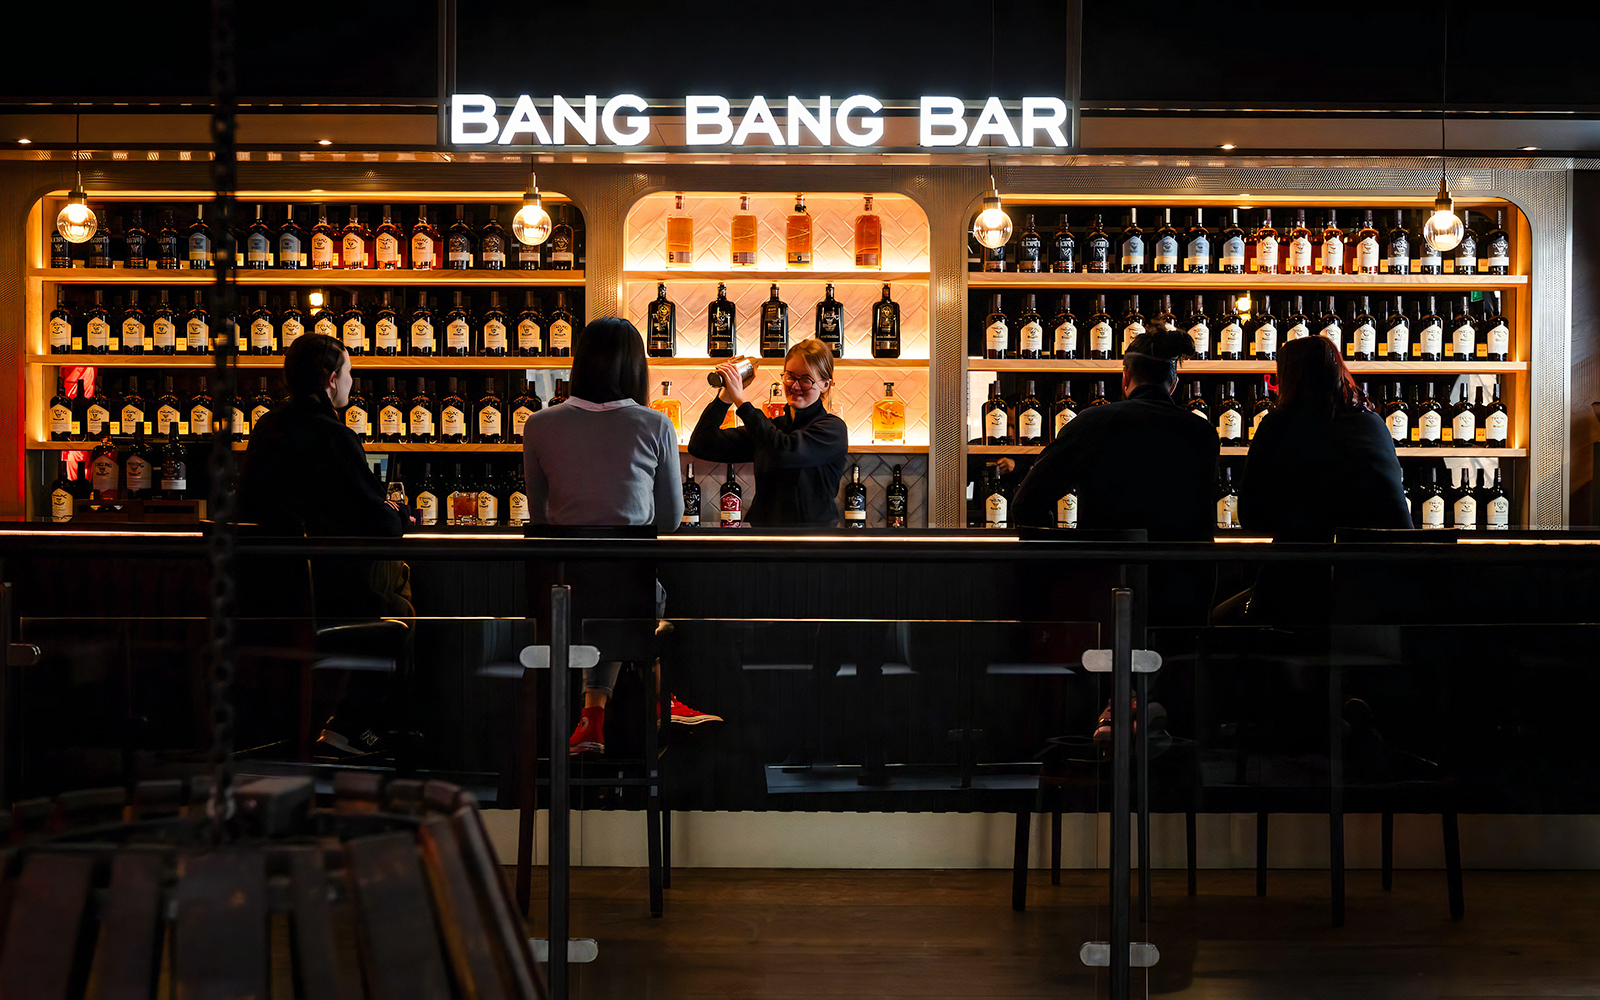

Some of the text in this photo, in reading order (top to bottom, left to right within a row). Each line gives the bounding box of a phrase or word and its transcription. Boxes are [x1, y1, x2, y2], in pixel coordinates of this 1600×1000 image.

[452, 95, 1068, 146] BANG BANG BAR
